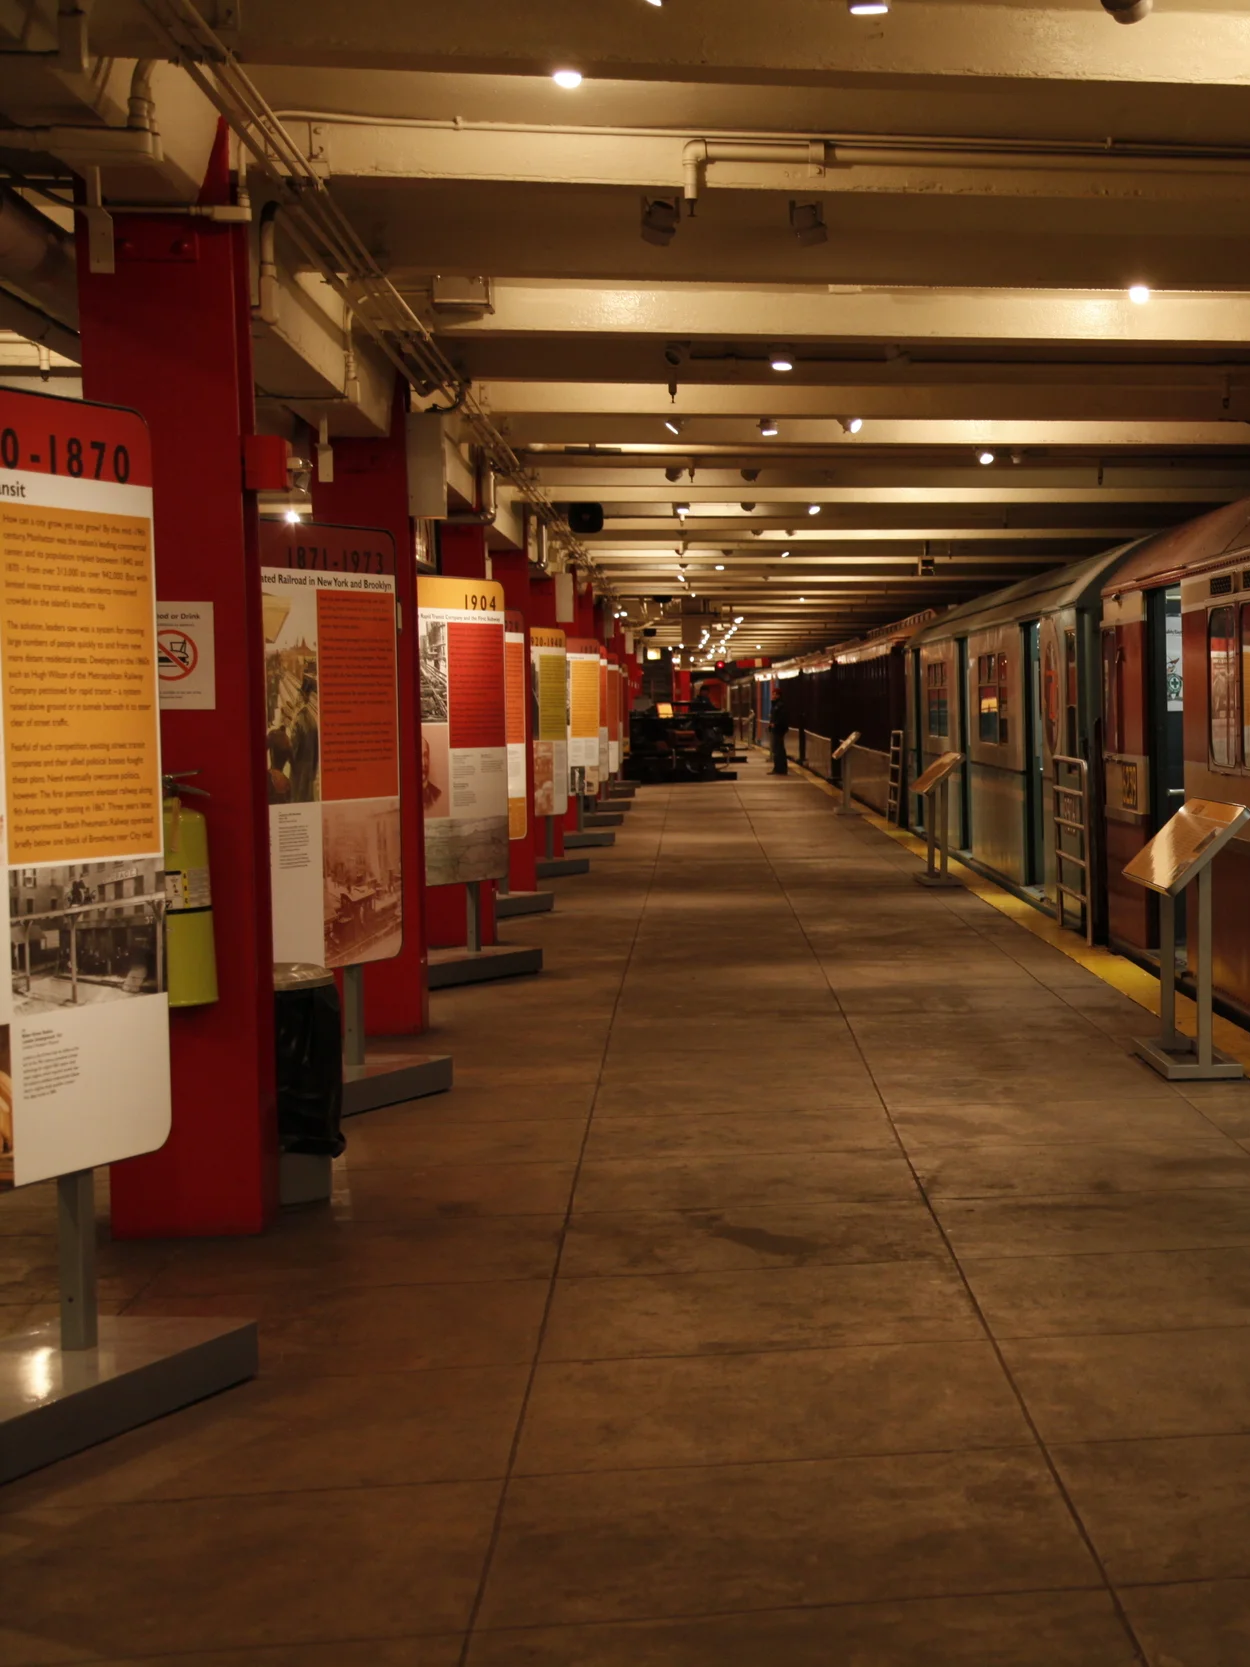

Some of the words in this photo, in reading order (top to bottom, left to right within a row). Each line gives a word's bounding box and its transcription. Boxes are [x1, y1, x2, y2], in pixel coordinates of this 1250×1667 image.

[278, 574, 307, 586] Railroad
[309, 577, 316, 586] in
[317, 576, 332, 587] New
[333, 577, 349, 588] York
[350, 579, 362, 589] and
[364, 579, 392, 592] Brooklyn
[464, 594, 496, 611] 1904
[180, 612, 201, 620] Drink
[445, 614, 463, 622] Company
